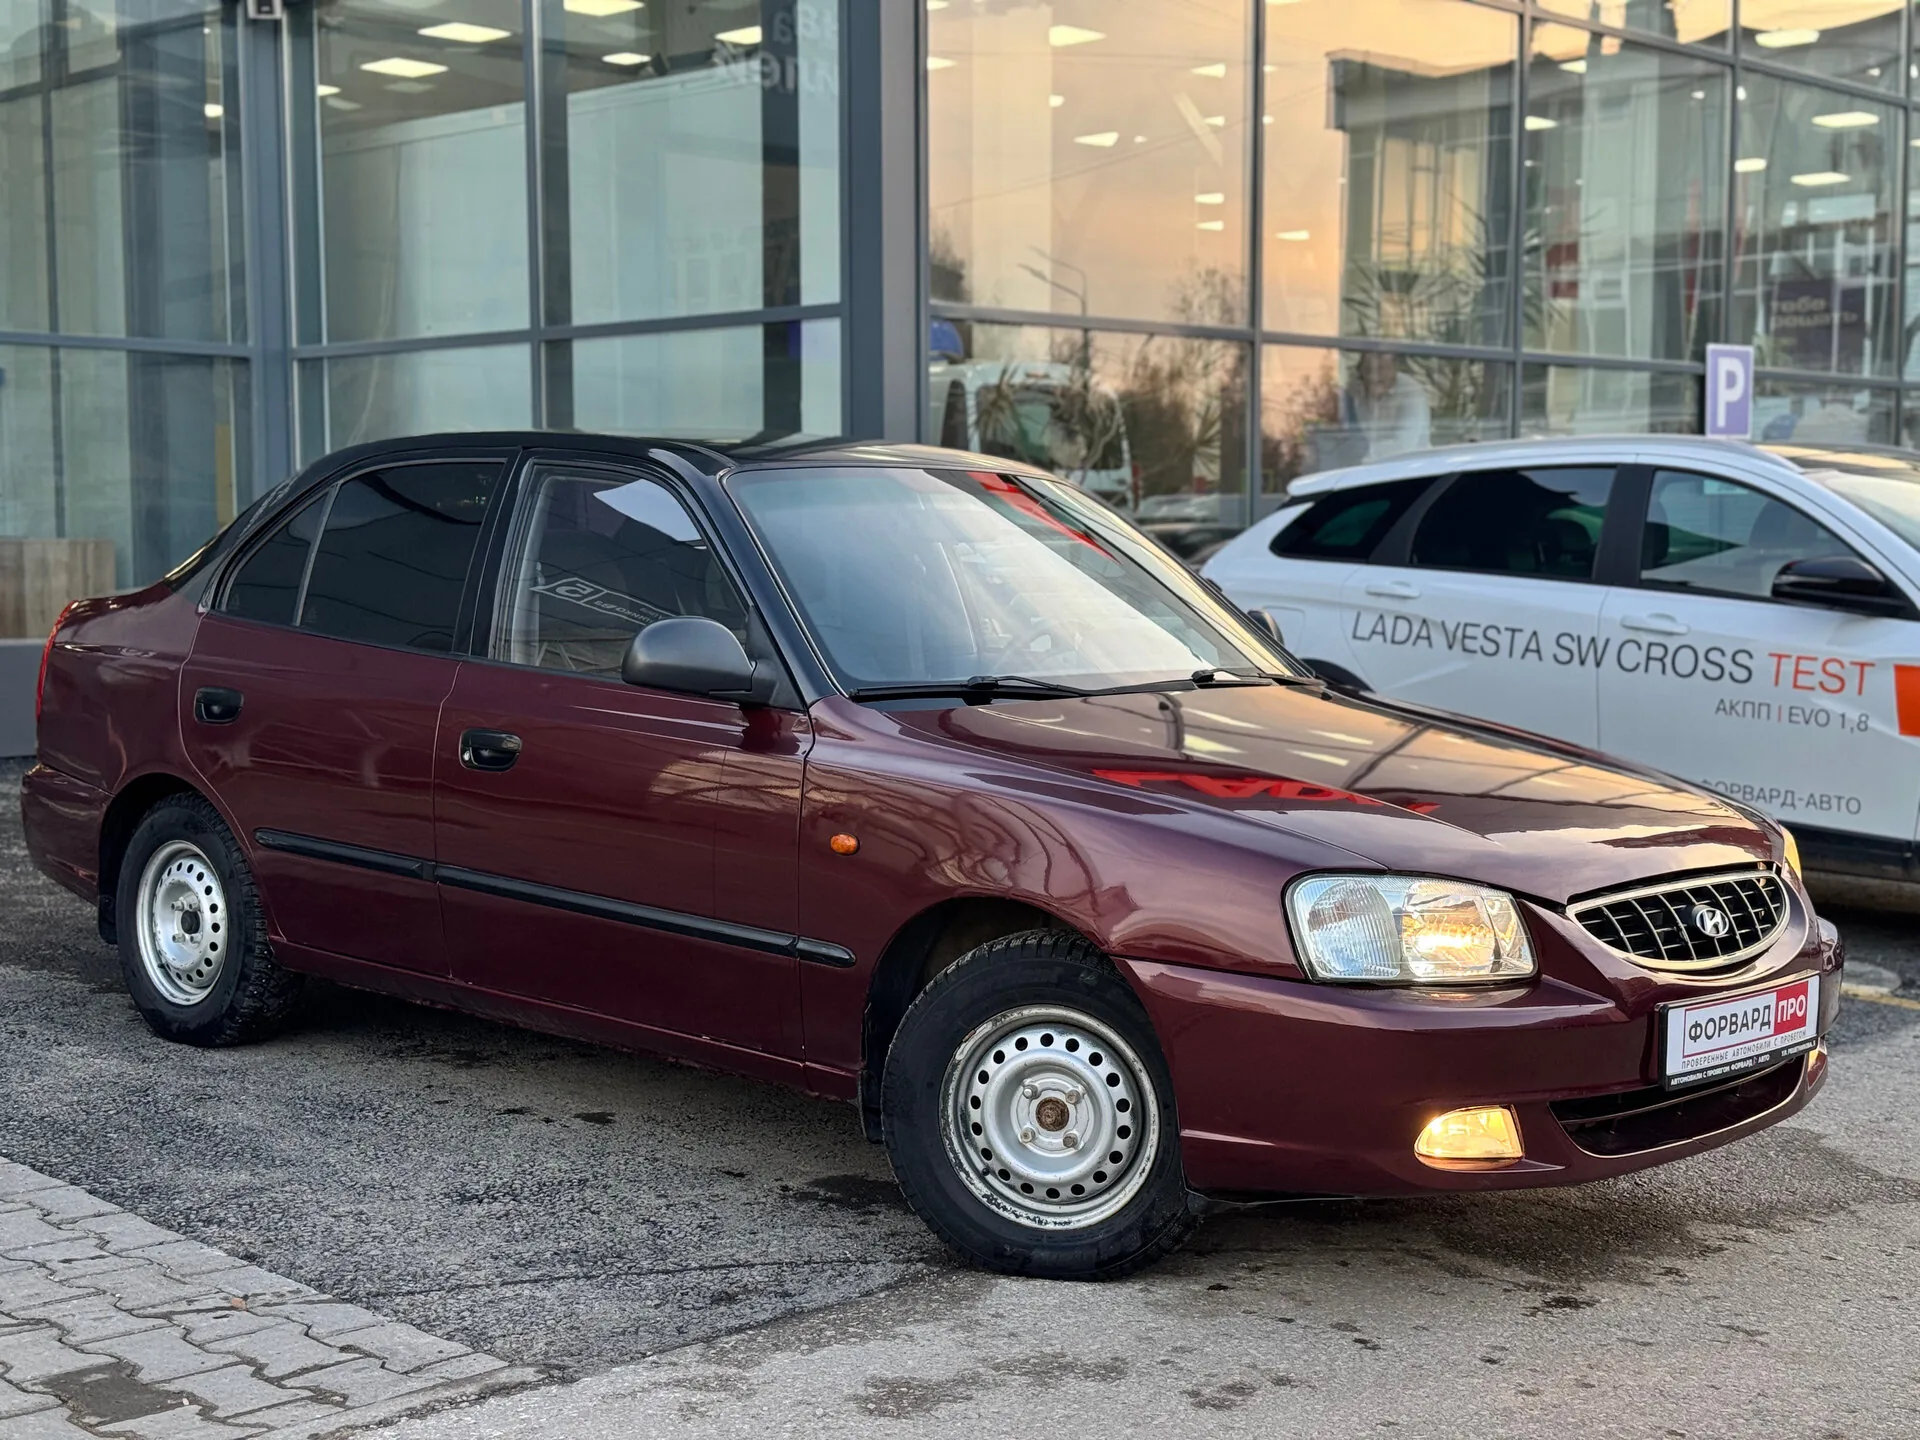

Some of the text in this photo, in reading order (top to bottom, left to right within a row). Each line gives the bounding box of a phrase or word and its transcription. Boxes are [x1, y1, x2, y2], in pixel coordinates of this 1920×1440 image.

[1717, 356, 1745, 428] P
[1351, 610, 1876, 696] LADA VESTA SW CROSS TEST
[1714, 698, 1870, 734] АКПП EVO 1,8
[1701, 778, 1862, 815] ОРВАРД-АВТО
[1688, 994, 1806, 1043] ФОРВАРД ПРО
[1681, 1051, 1729, 1069] ПРОВЕРЕННЫЕ
[1732, 1041, 1771, 1058] АВТОМОБИЛИ
